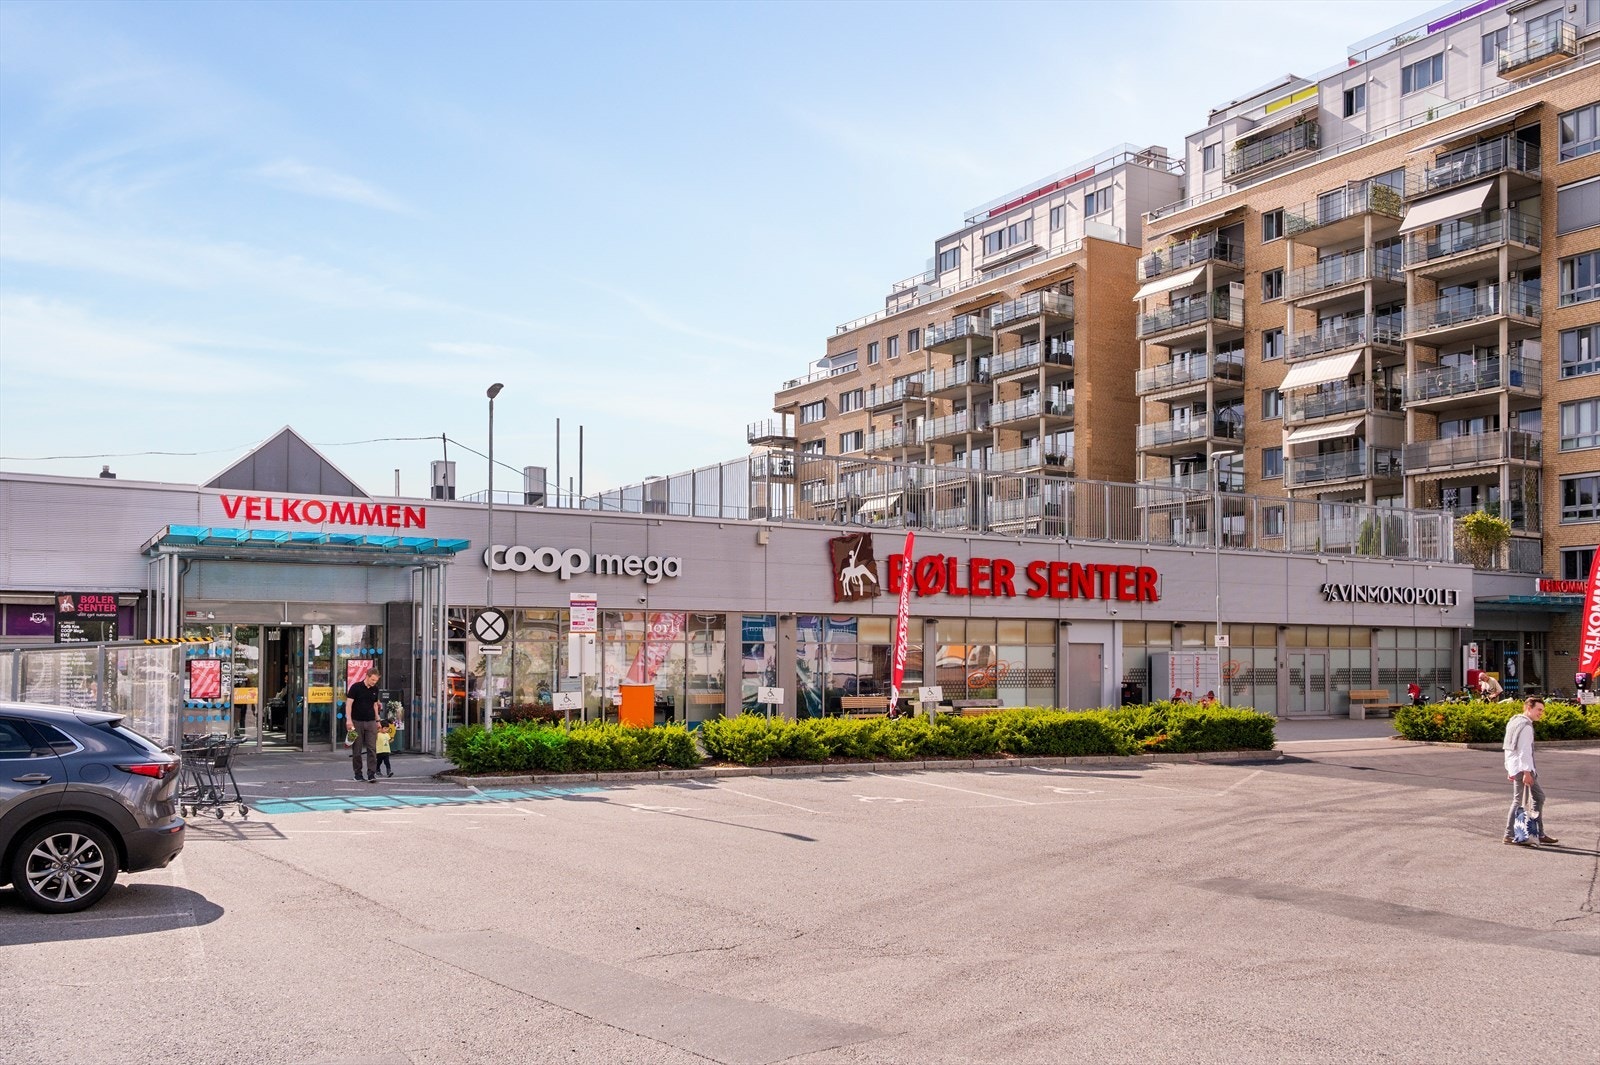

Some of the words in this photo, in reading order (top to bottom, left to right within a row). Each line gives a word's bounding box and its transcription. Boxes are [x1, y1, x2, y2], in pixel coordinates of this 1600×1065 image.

[219, 495, 426, 529] VELKOMMEN
[484, 544, 590, 580] coop
[595, 553, 682, 584] mega
[888, 553, 1016, 597] BØLER
[1026, 560, 1160, 602] SENTER
[81, 595, 114, 603] BØLER
[1338, 583, 1462, 606] VINMONOPOLET
[77, 604, 116, 612] SENTER
[349, 660, 368, 668] SALG
